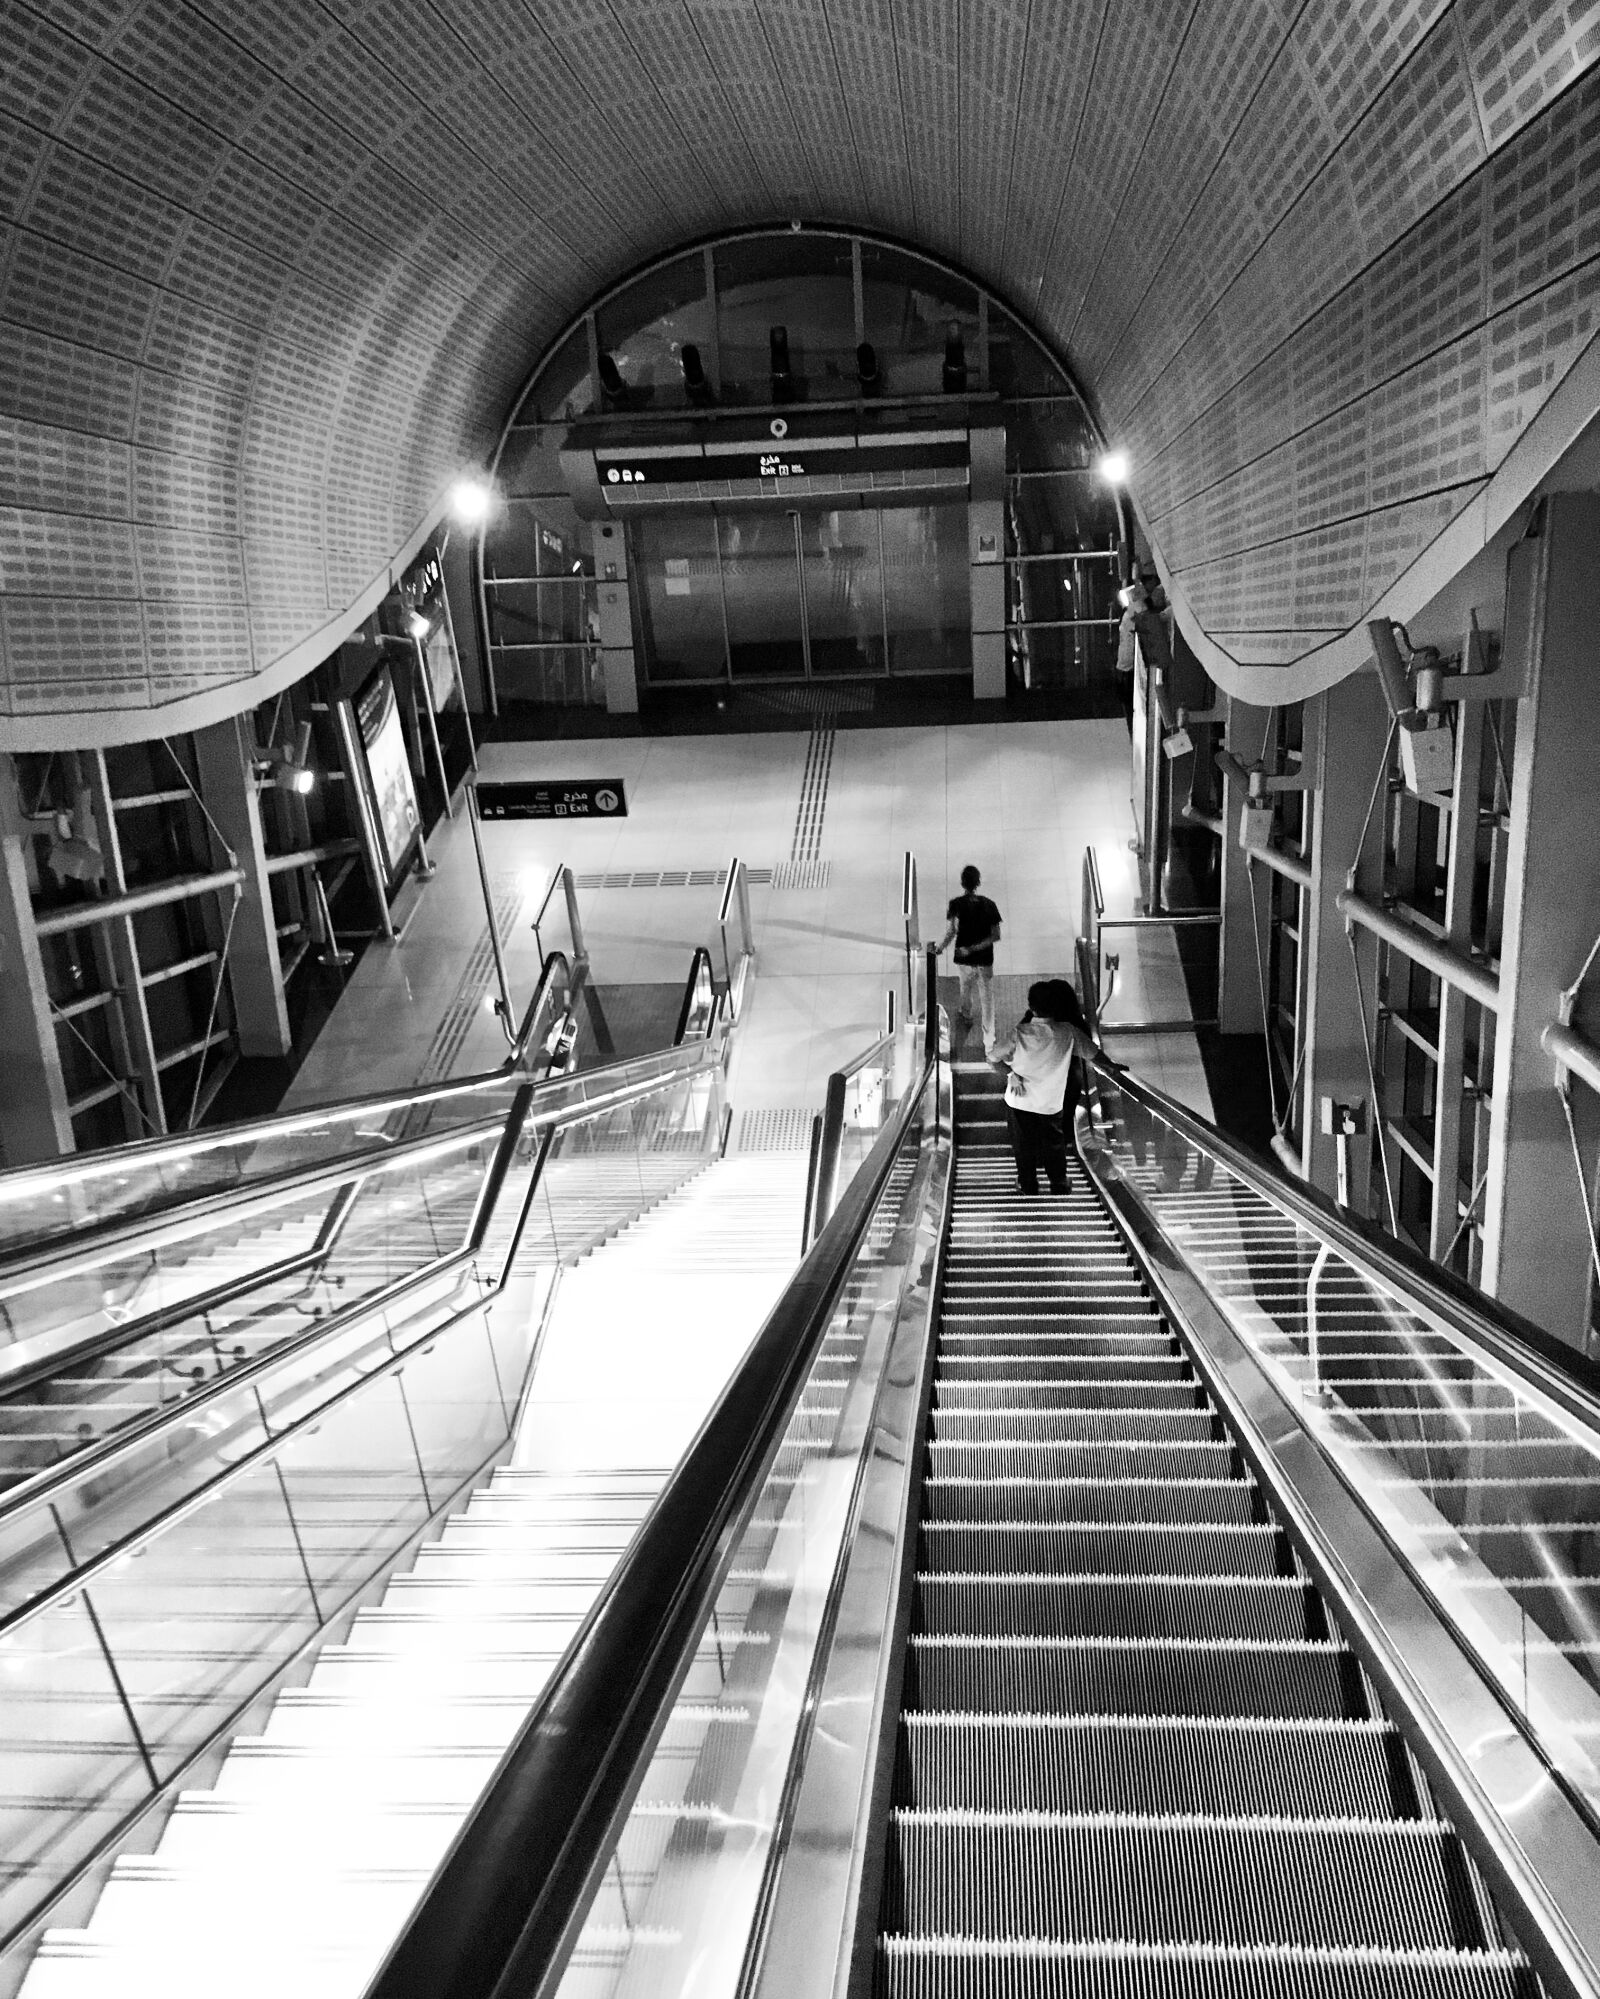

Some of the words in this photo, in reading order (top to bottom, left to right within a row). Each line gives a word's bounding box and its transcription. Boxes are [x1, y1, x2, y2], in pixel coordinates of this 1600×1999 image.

[760, 465, 777, 476] Exit
[564, 792, 588, 802] مخرج
[570, 803, 589, 813] Exit
